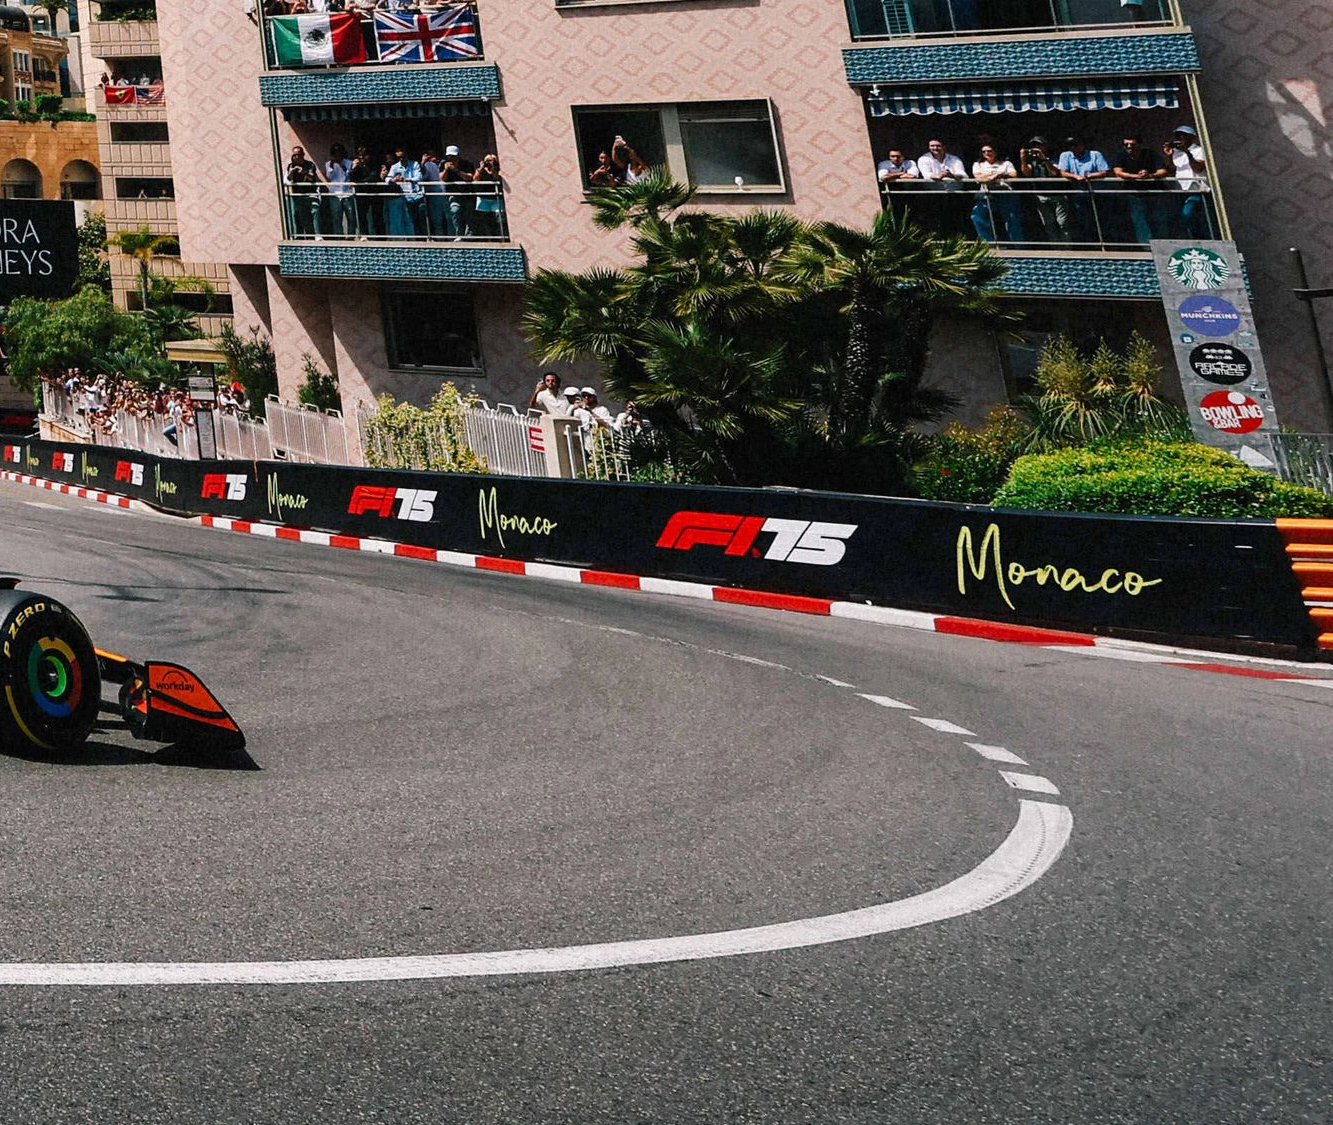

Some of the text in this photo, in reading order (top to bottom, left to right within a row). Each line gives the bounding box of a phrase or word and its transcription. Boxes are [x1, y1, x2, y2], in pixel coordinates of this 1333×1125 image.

[1181, 312, 1238, 320] MUNCHKINS
[1194, 362, 1247, 372] ARCADE
[1200, 368, 1245, 376] GAMES
[1200, 405, 1264, 421] BOWLING
[1213, 418, 1242, 429] &BAR
[130, 463, 144, 486] 75
[200, 473, 248, 501] F1 75
[266, 472, 309, 521] Monaco
[347, 485, 438, 522] F1 75
[479, 486, 558, 549] Monaco
[656, 510, 858, 566] F1 75
[956, 522, 1163, 610] Monaco
[4, 602, 45, 658] P ZERO
[156, 680, 195, 693] workday
